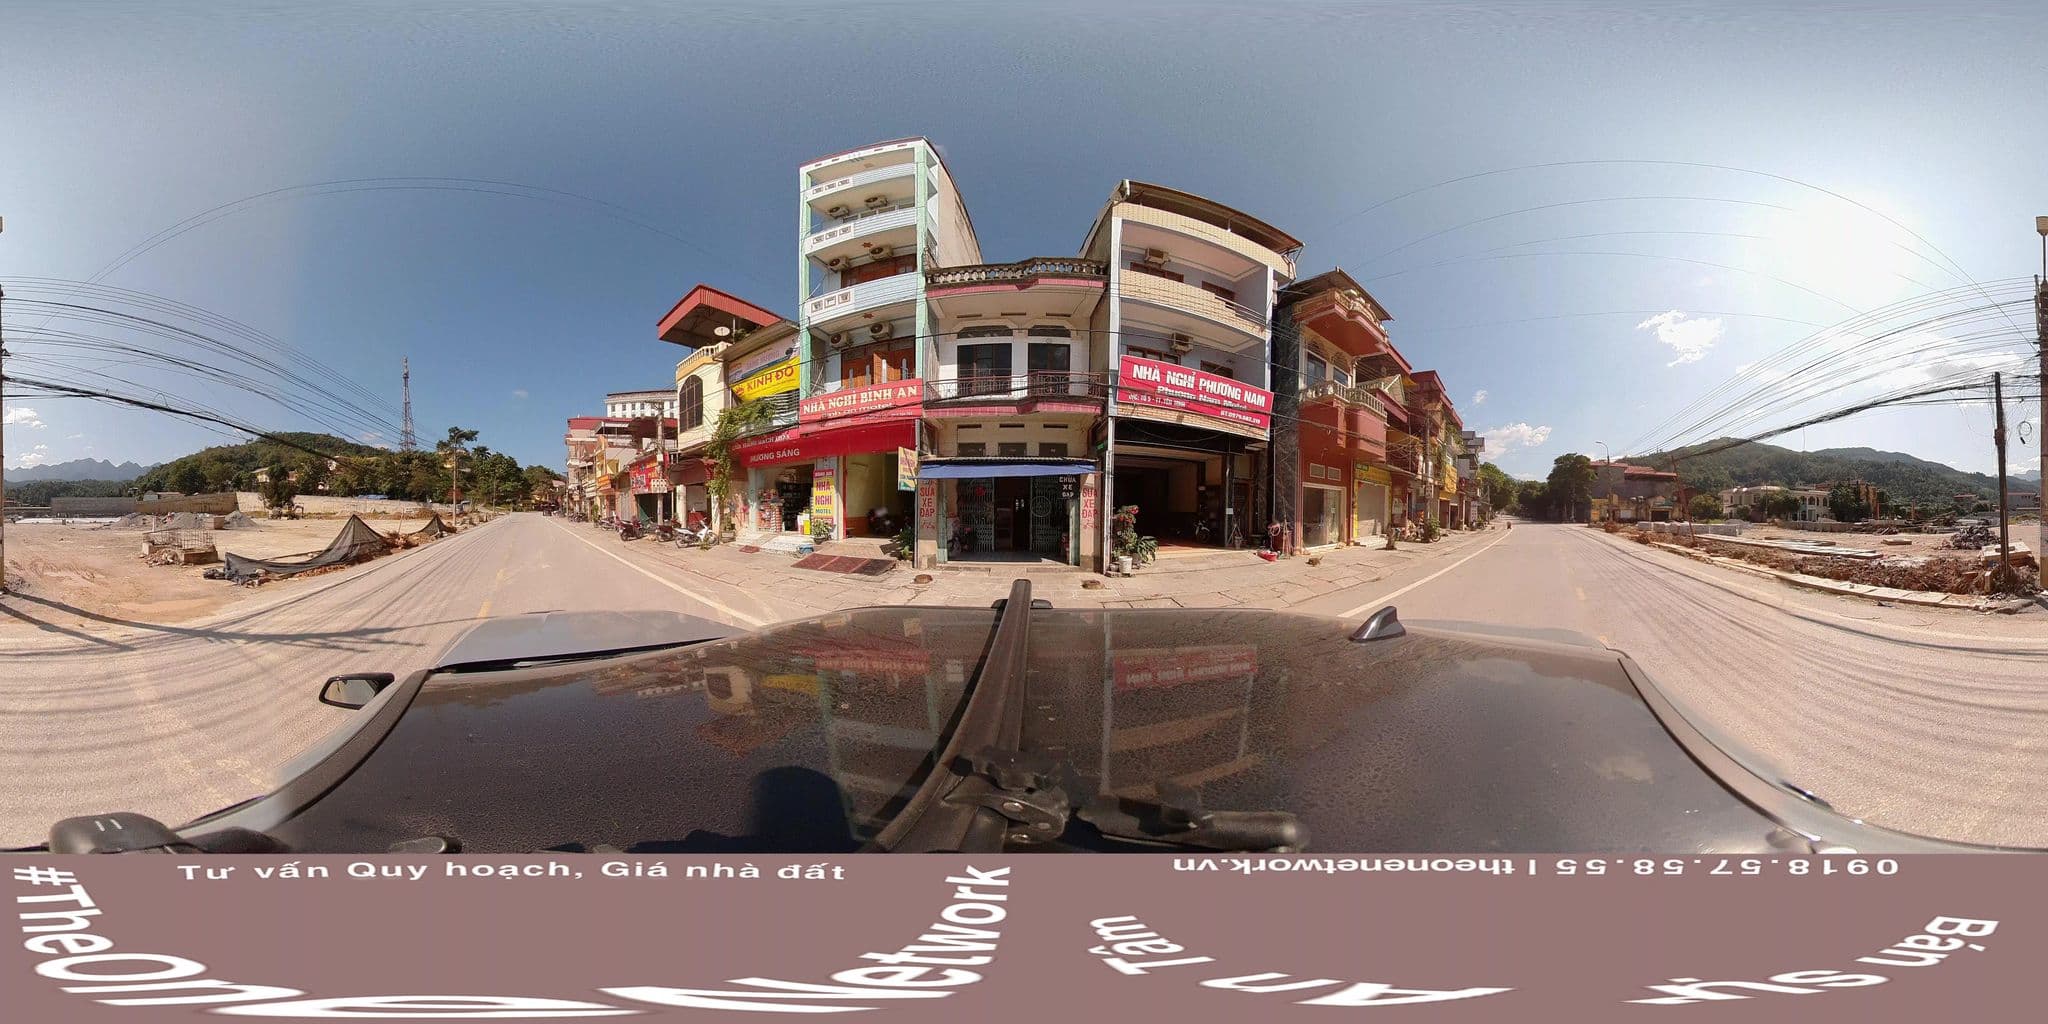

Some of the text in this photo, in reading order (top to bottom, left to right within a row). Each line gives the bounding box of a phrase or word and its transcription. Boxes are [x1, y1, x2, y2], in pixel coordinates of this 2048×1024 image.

[747, 364, 794, 391] KINH ĐÔ
[1133, 364, 1266, 407] NHÀ NGHỈ PHƯƠNG NAM
[803, 386, 917, 414] NHÀ NGHỈ BÌNH AN
[776, 448, 800, 459] SÁNG
[922, 498, 933, 507] XE
[1083, 499, 1095, 509] XE
